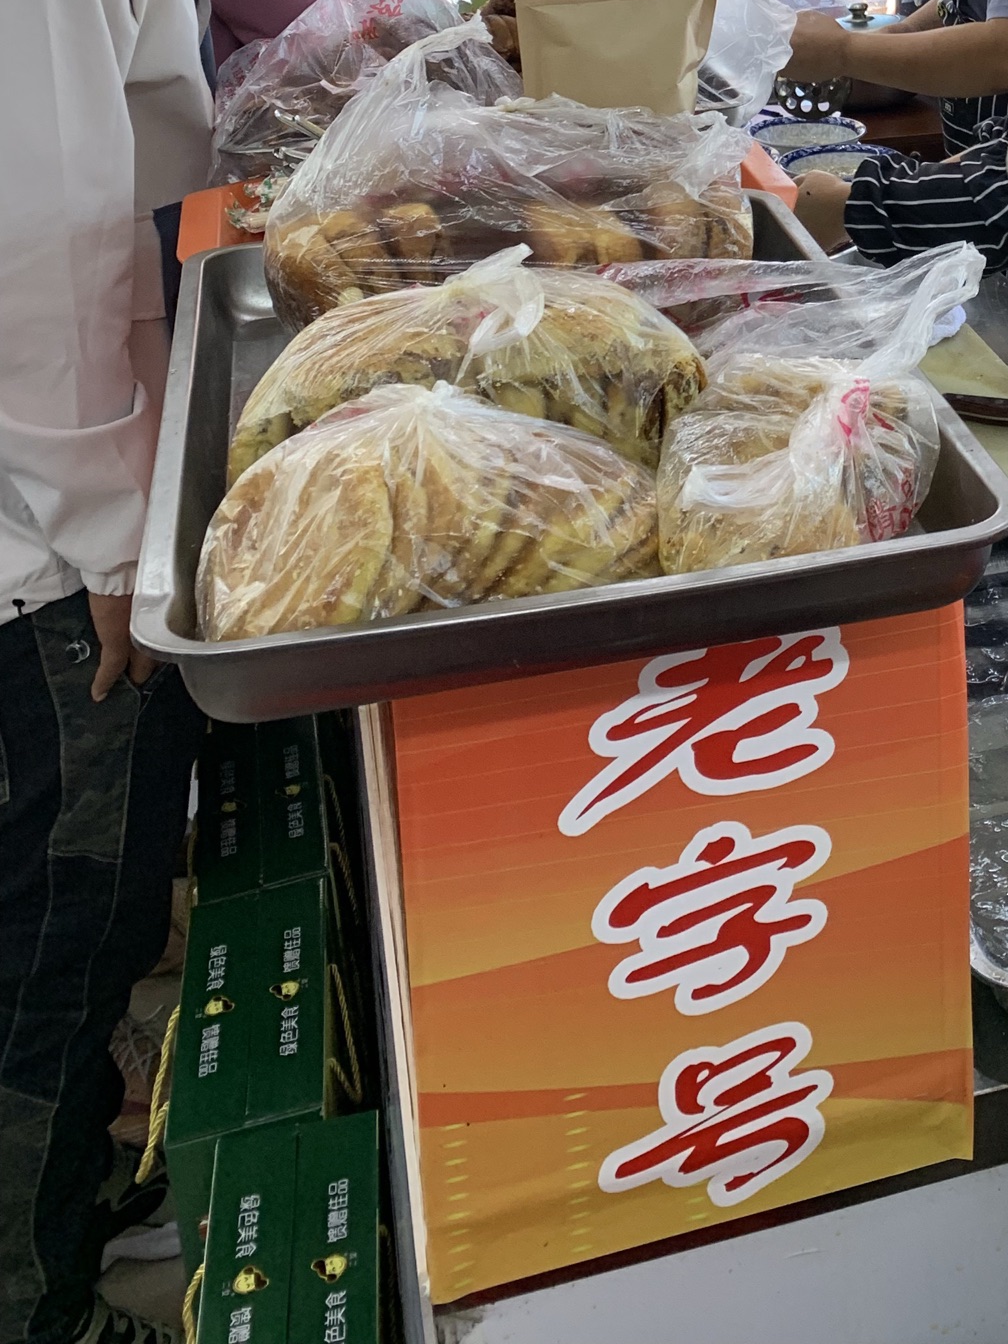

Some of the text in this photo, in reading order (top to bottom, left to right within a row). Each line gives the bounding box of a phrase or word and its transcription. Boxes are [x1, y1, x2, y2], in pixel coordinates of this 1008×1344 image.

[557, 627, 849, 1207] 老字号
[205, 944, 228, 992] 绿色美食
[279, 1005, 300, 1057] 绿色美食
[235, 1193, 261, 1259] 绿色美食
[326, 1177, 350, 1244] 馈赠佳品
[323, 1289, 348, 1344] 色美食
